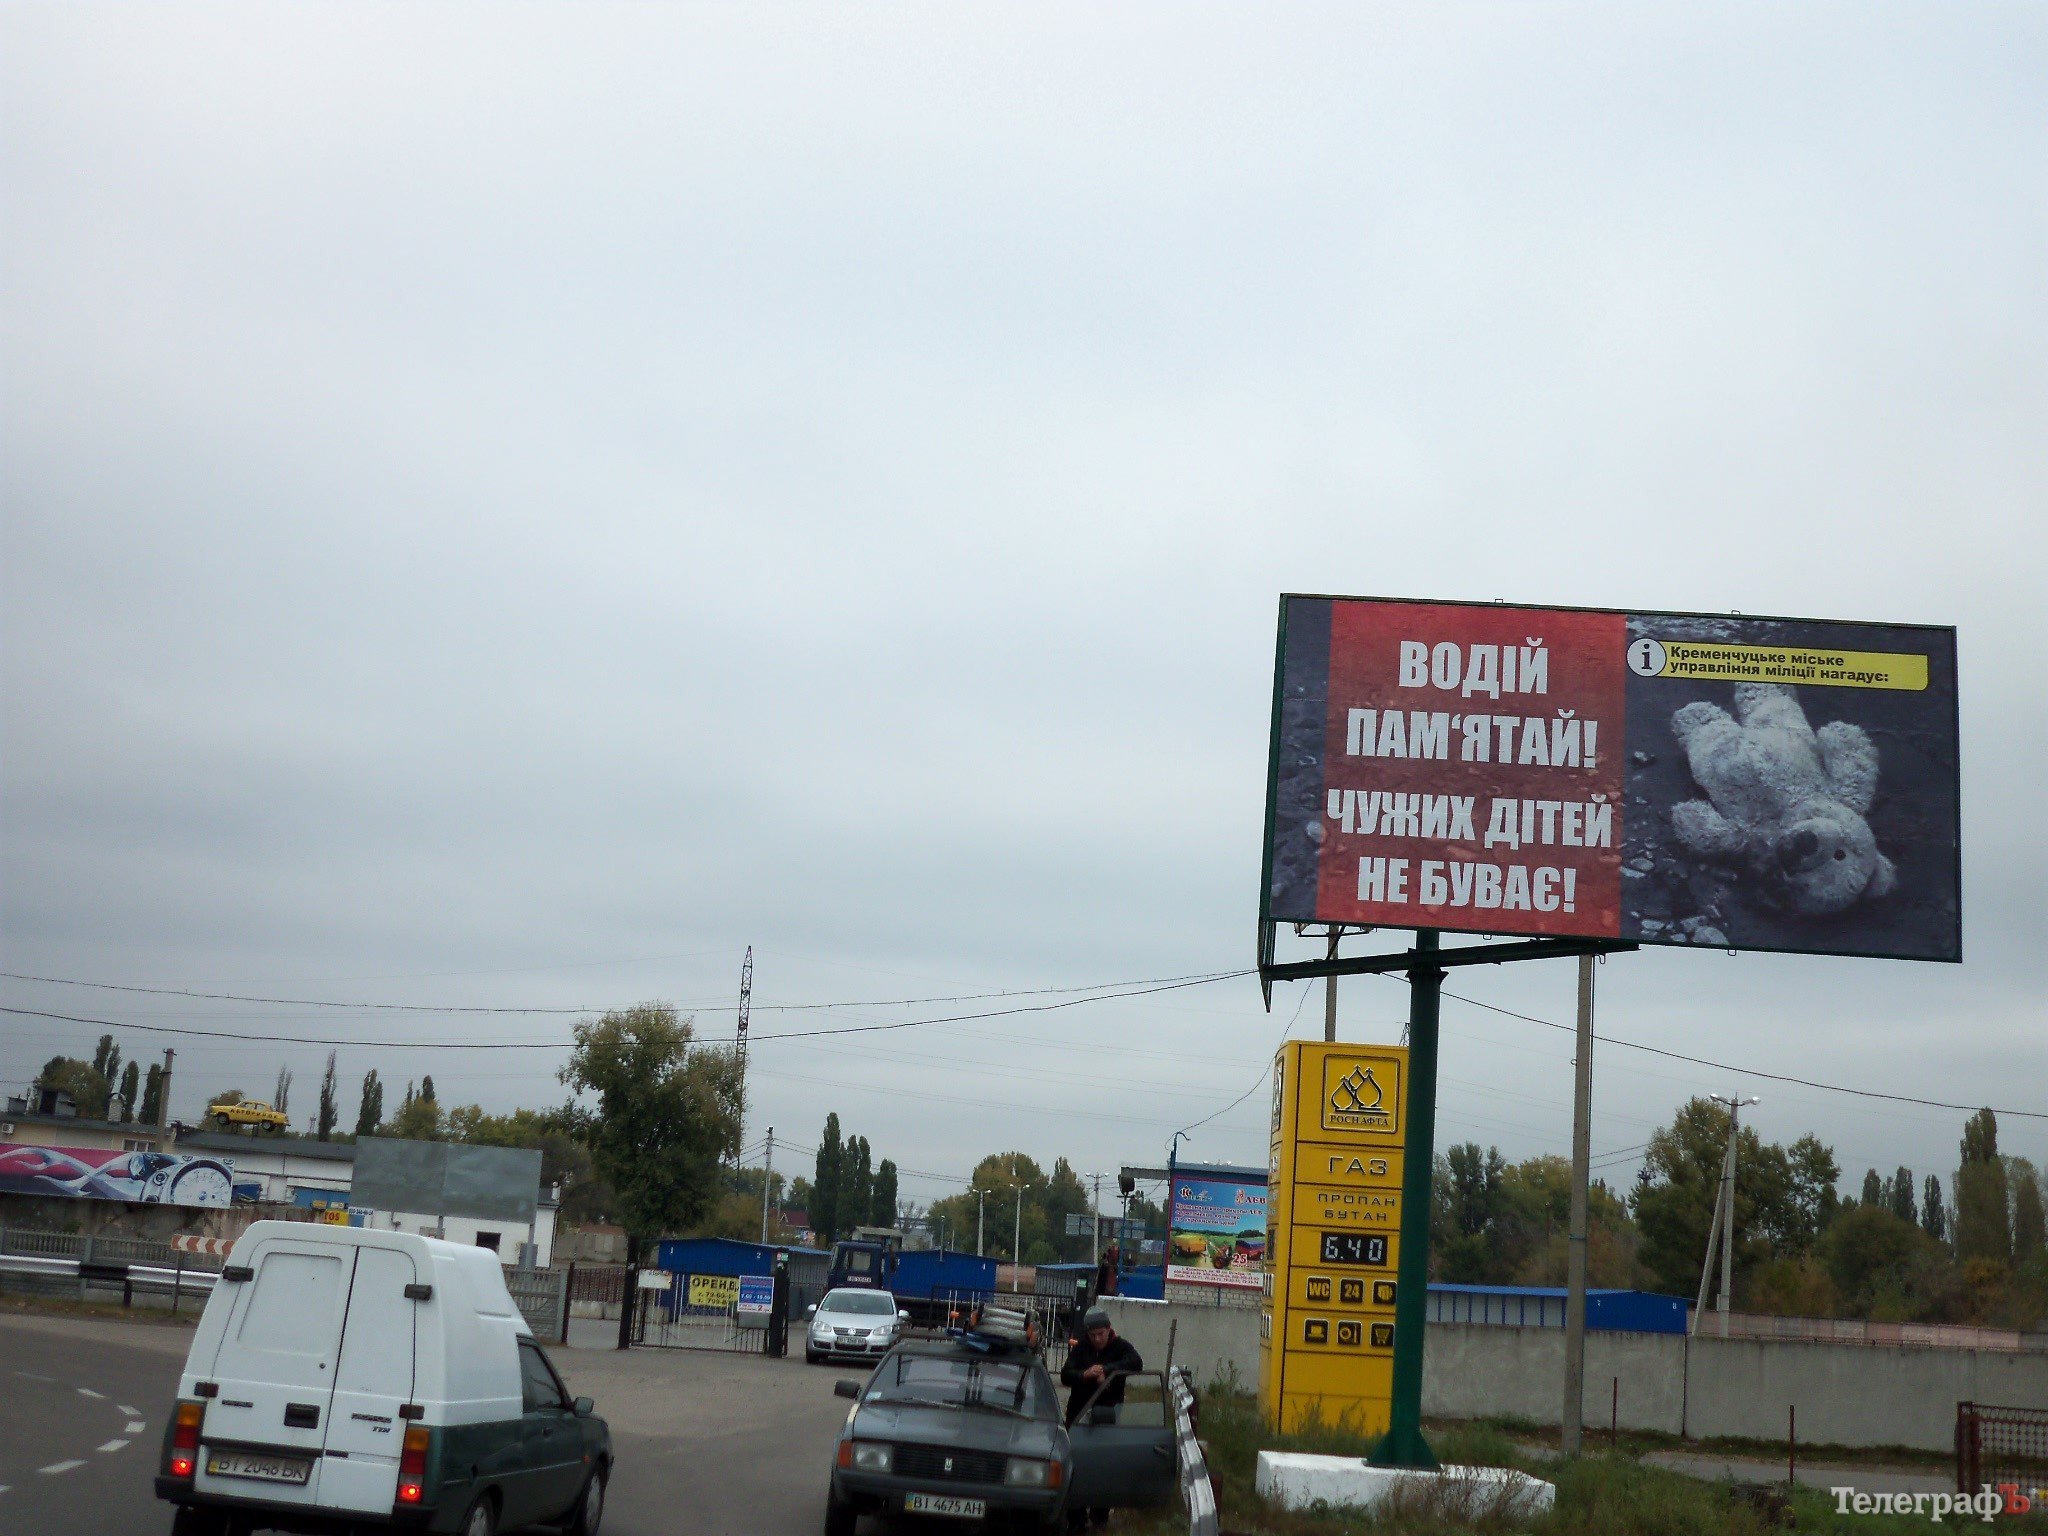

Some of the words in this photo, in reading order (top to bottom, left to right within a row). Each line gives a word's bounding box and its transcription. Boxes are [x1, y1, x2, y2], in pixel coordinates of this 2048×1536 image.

[1670, 646, 1786, 664] Кременчуцьке
[1791, 652, 1844, 667] міське
[1399, 637, 1548, 699] ВОДІЙ
[1670, 660, 1760, 676] управління
[1765, 664, 1815, 679] міліції
[1820, 669, 1889, 683] нагадує:
[1327, 788, 1476, 841] ЧУЖИХ
[1484, 793, 1612, 851] ДІТЕЙ
[1357, 856, 1409, 903] НЕ
[1419, 859, 1577, 913] БУВАЄ!
[1329, 1114, 1389, 1126] РОСНАФТА
[1328, 1156, 1387, 1176] ГАЗ
[1318, 1193, 1395, 1207] ПРОПАН
[1324, 1209, 1387, 1222] БУТАН
[1325, 1236, 1383, 1262] 6.40
[1232, 1254, 1248, 1265] 25
[1309, 1281, 1330, 1297] WC
[1344, 1284, 1360, 1298] 24
[933, 1499, 961, 1513] 4675
